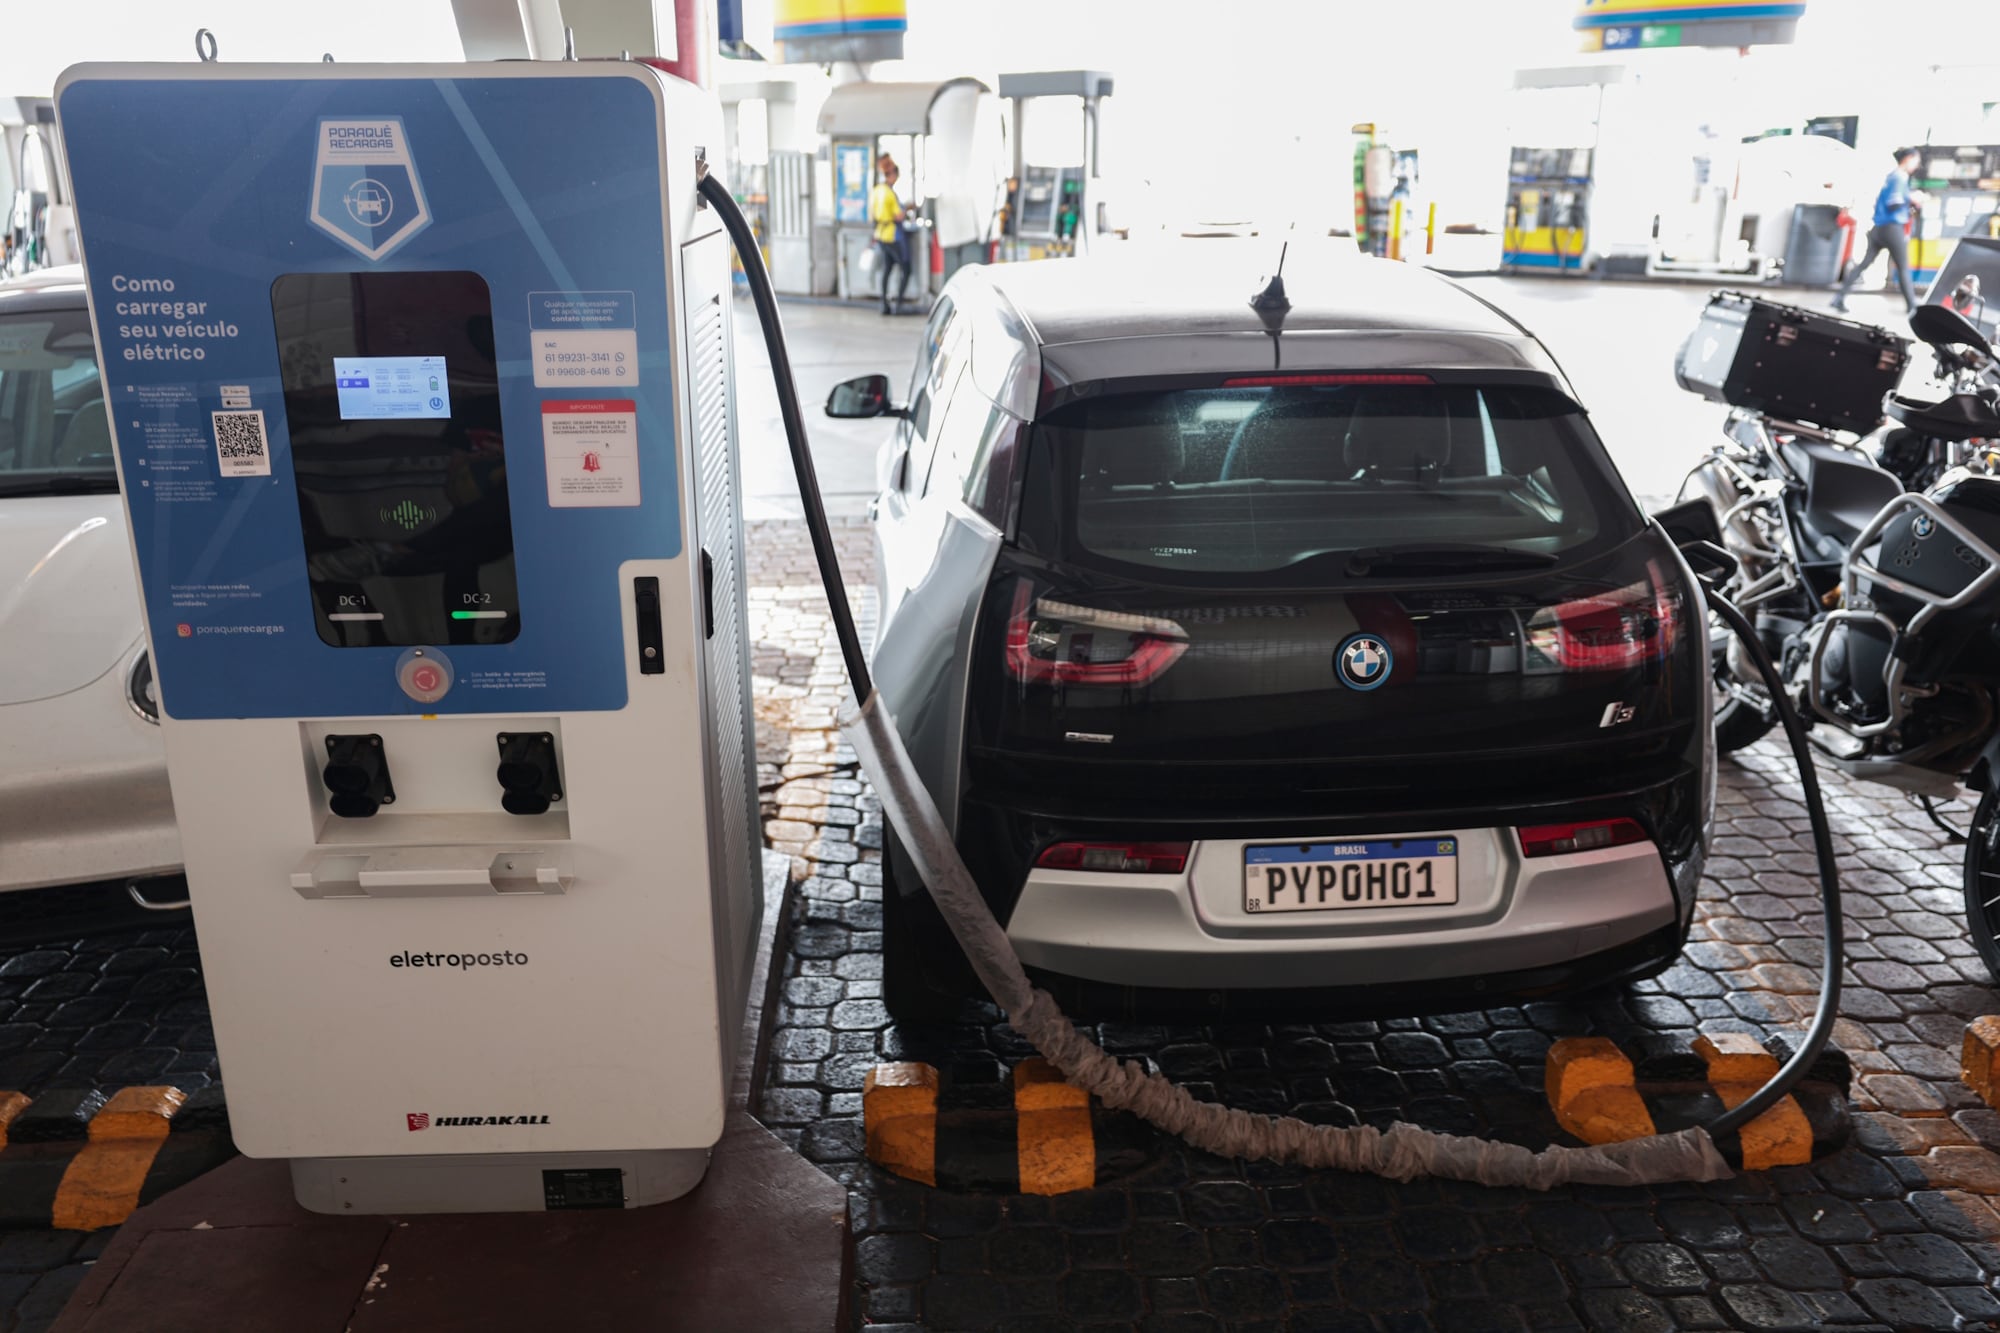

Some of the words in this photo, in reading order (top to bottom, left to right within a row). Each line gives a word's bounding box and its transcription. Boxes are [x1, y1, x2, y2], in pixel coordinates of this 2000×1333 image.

[328, 124, 393, 138] PORAQUÊ
[330, 139, 394, 149] RECARGAS
[111, 275, 175, 293] Como
[116, 301, 207, 319] carregar
[543, 300, 575, 309] Qualquer
[576, 300, 619, 308] necessidade
[119, 323, 157, 338] seu
[162, 320, 239, 338] veículo
[123, 343, 206, 361] elétrico
[545, 353, 555, 363] 61
[558, 353, 610, 362] 99231-3141
[546, 368, 556, 376] 61
[558, 367, 611, 376] 99608-6416
[339, 595, 367, 606] DC-1
[463, 593, 491, 604] DC-2
[196, 624, 285, 635] poraquerecargas
[1599, 701, 1636, 728] i3
[1334, 845, 1368, 856] BRASIL
[1265, 861, 1436, 905] PYP0H01
[1248, 898, 1261, 911] BR
[390, 950, 529, 971] eletroposto
[435, 1115, 551, 1127] HURAKALL
